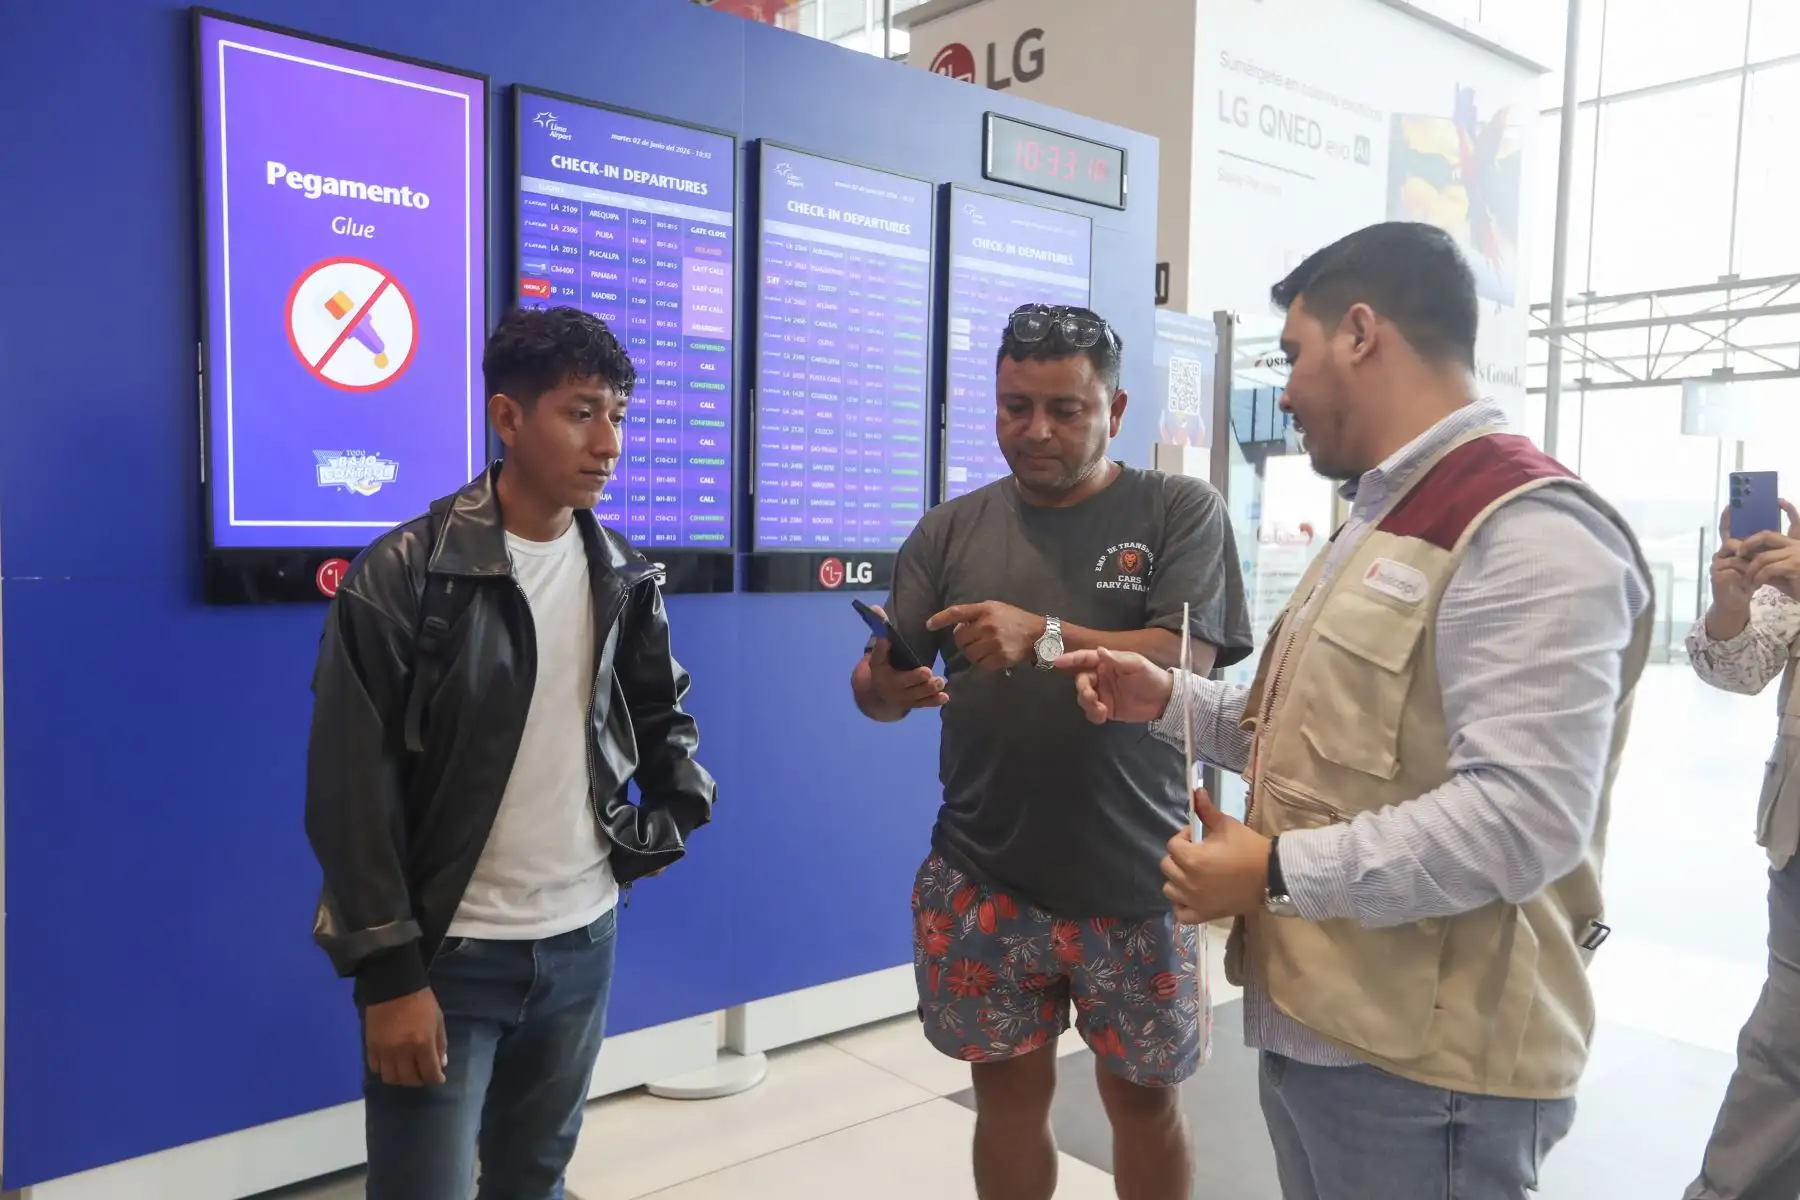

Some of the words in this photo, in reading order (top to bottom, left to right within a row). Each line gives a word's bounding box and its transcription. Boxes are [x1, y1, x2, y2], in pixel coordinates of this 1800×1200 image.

[986, 28, 1045, 91] LG
[550, 123, 568, 133] Lima
[1218, 88, 1249, 128] LG
[1259, 104, 1322, 150] QNED
[549, 131, 572, 141] Airport
[610, 134, 632, 143] martes
[641, 138, 649, 147] de
[649, 140, 665, 150] junio
[666, 144, 675, 152] del
[675, 147, 690, 155] 2026
[1015, 139, 1077, 181] 10:33
[266, 160, 430, 209] Pegamento
[551, 154, 620, 179] CHECK-IN
[623, 167, 708, 196] DEPARTURES
[331, 215, 376, 239] Glue
[551, 203, 560, 211] LA
[562, 205, 578, 214] 2109
[589, 210, 620, 221] AREQUIPA
[690, 226, 707, 235] GATE
[787, 200, 840, 222] CHECK-IN
[843, 211, 911, 235] DEPARTURES
[551, 223, 560, 231] LA
[562, 225, 578, 234] 2306
[595, 230, 615, 240] PIURA
[551, 244, 560, 252] LA
[562, 246, 578, 255] 2015
[589, 249, 620, 261] PUCALLPA
[972, 236, 1016, 255] CHECK-IN
[1018, 245, 1075, 266] DEPARTURES
[551, 265, 575, 275] CM400
[562, 287, 574, 296] 124
[591, 291, 617, 301] MADRID
[700, 363, 716, 371] CALL
[1486, 363, 1522, 388] Good.
[700, 401, 716, 409] CALL
[700, 438, 715, 446] CALL
[699, 495, 715, 503] CALL
[1094, 555, 1108, 573] EMP.
[1106, 545, 1119, 554] DE
[845, 562, 873, 584] LG
[1118, 575, 1142, 584] CARS
[1096, 581, 1122, 589] GARY
[1122, 582, 1131, 590] &
